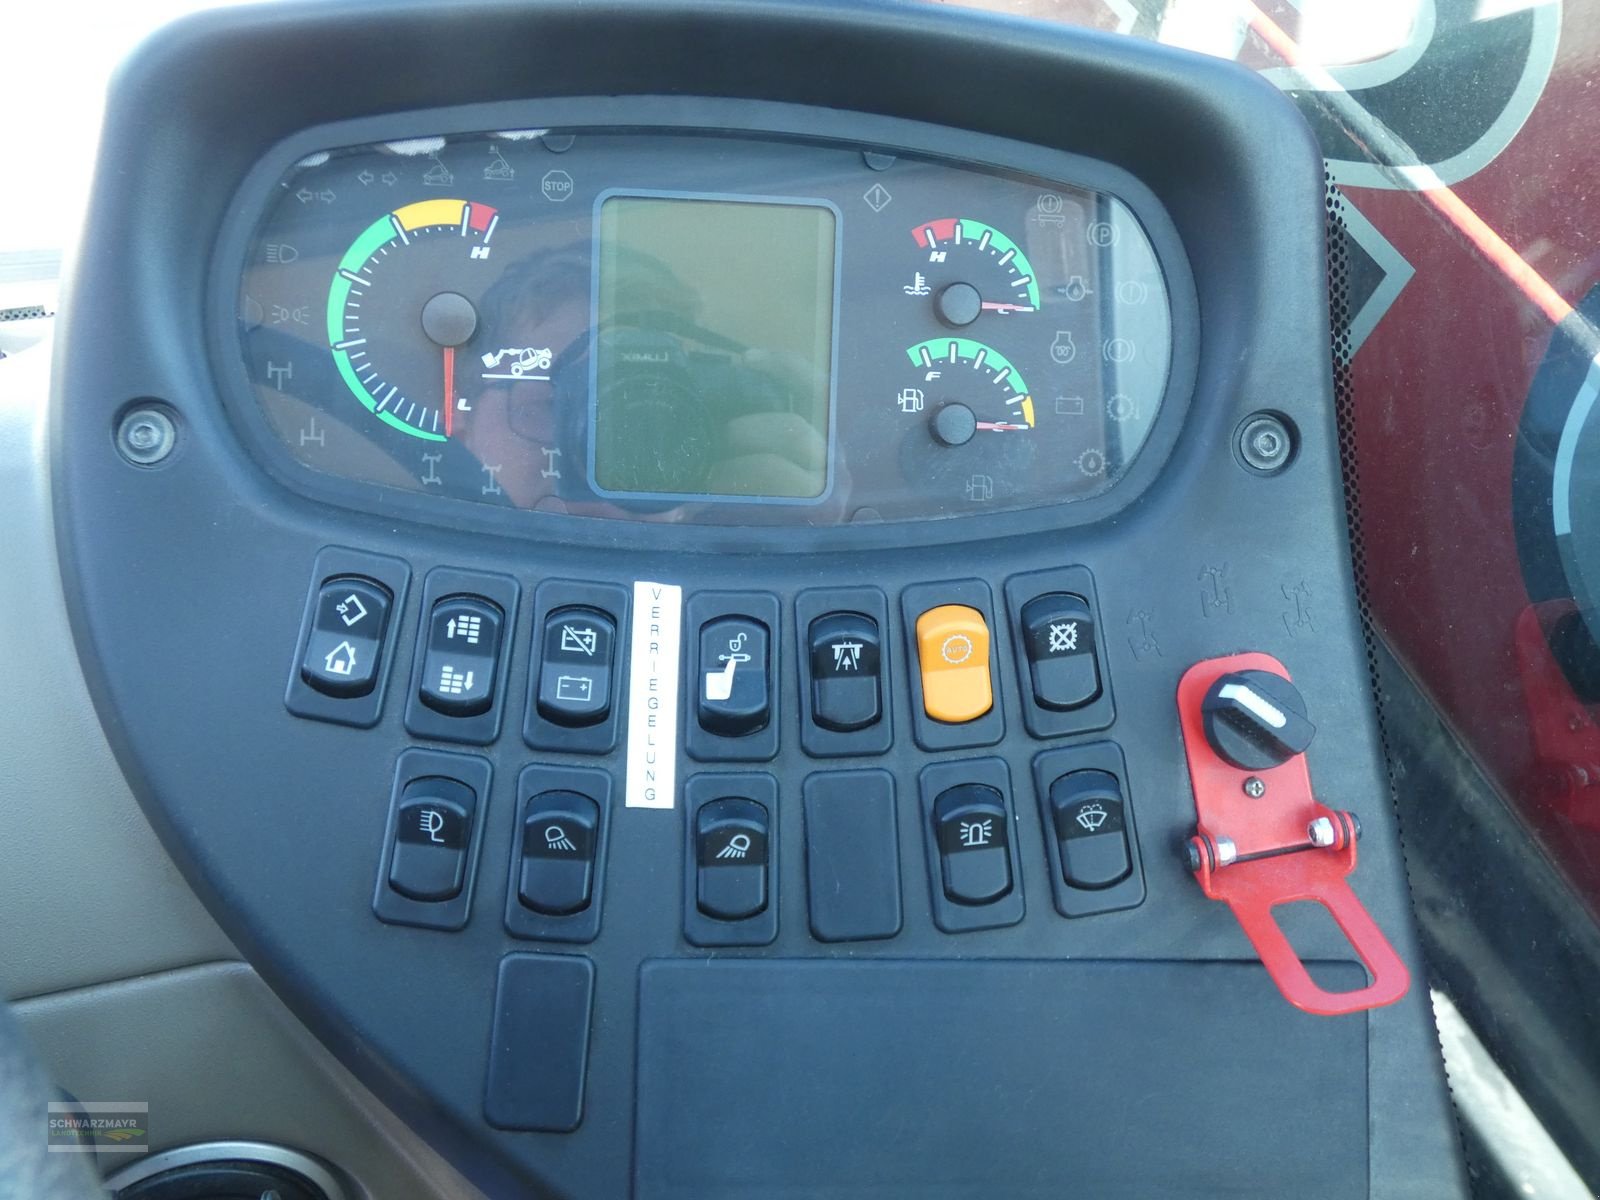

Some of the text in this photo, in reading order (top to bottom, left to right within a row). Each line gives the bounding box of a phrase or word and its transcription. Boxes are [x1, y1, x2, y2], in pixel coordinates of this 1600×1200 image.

[544, 181, 571, 192] STOP
[470, 246, 490, 259] H
[929, 251, 947, 262] H
[925, 371, 941, 381] F
[457, 398, 472, 411] L
[645, 588, 662, 801] VERRIEGELUNG
